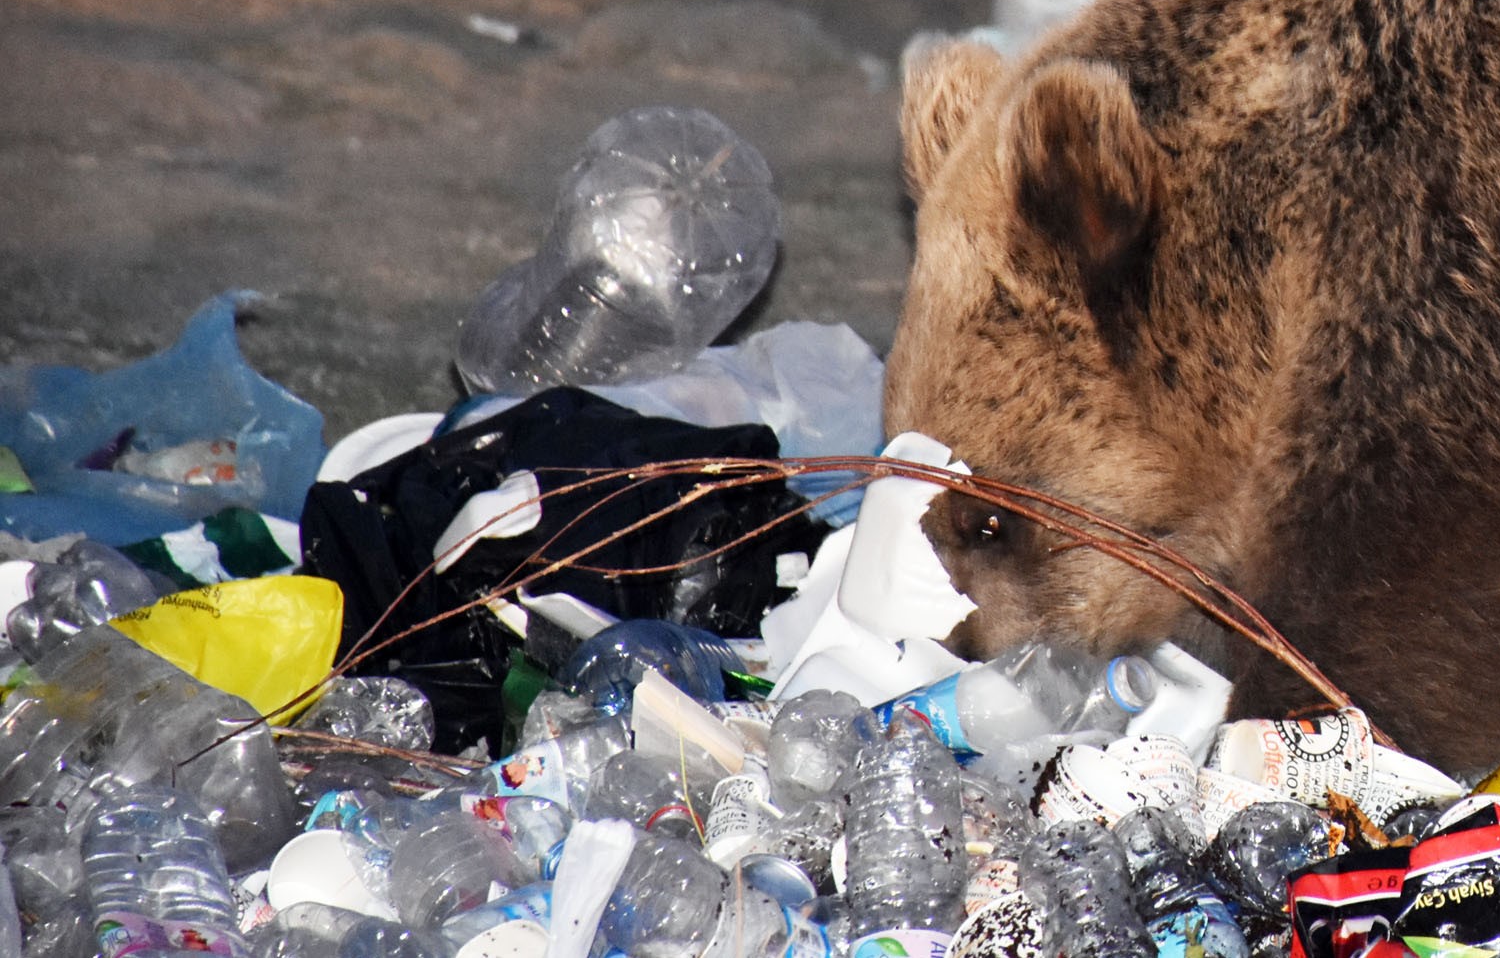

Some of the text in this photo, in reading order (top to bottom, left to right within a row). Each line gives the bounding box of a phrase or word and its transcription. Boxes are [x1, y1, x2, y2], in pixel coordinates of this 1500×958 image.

[1263, 731, 1284, 786] Coffee
[1286, 754, 1299, 789] kao
[1303, 762, 1311, 794] presso
[1312, 764, 1322, 802] ocolate
[1204, 810, 1223, 825] Cho
[1448, 879, 1495, 904] Siyah
